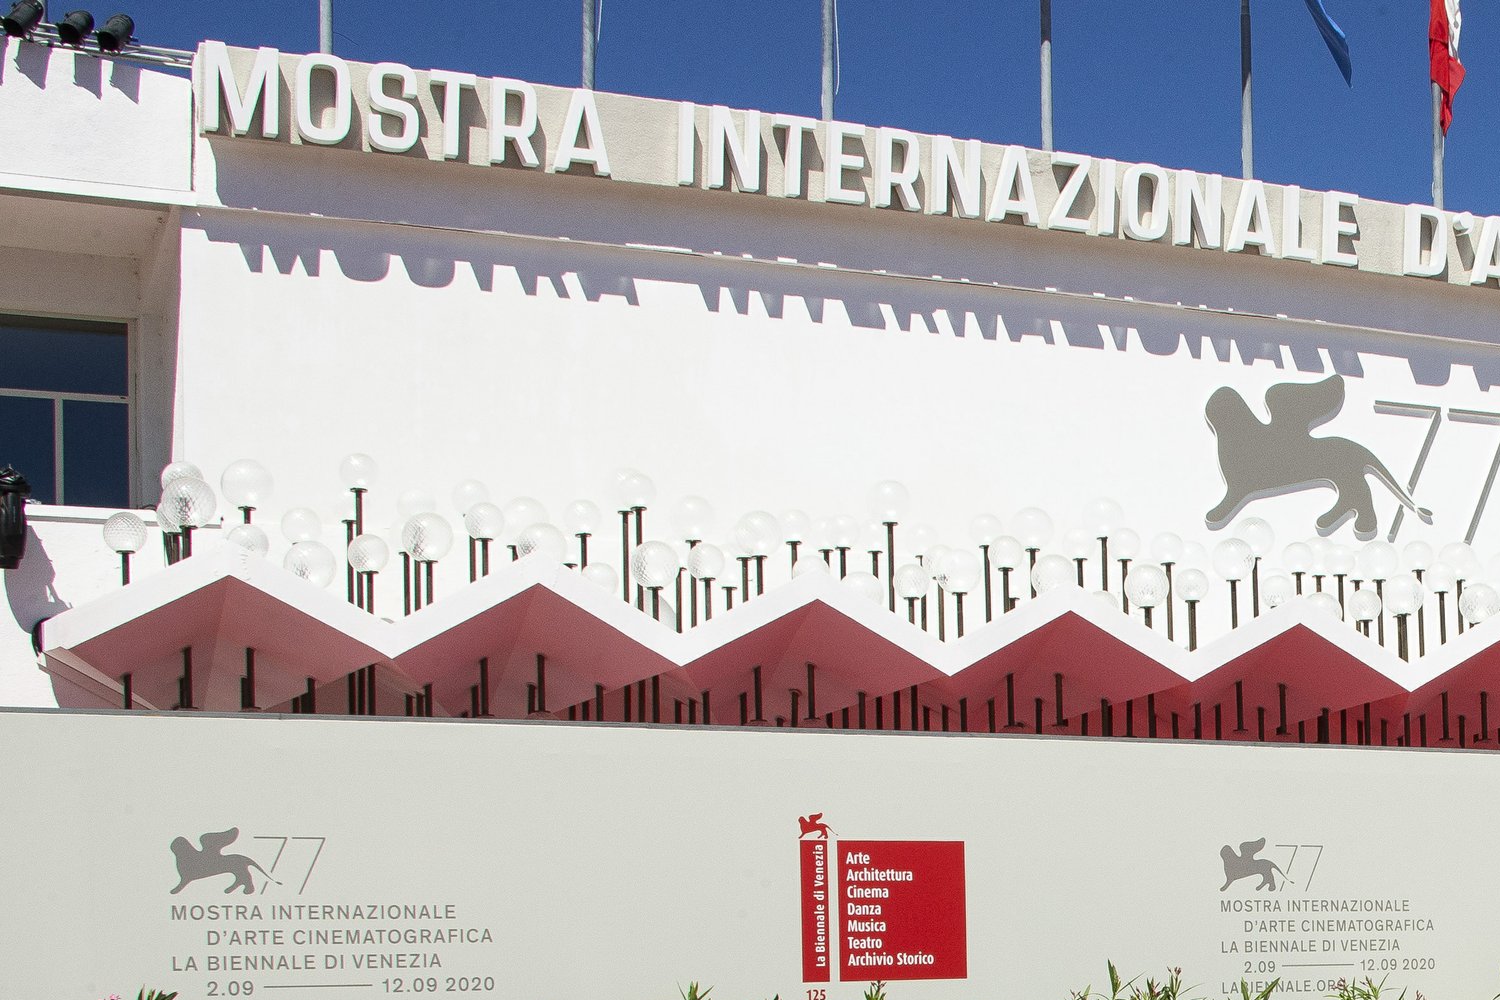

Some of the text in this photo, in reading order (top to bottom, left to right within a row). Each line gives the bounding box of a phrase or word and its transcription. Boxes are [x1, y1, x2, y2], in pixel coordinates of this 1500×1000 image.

[200, 39, 612, 177] MOSTRA
[678, 100, 1359, 267] INTERNAZIONALE
[253, 836, 326, 895] 77
[846, 852, 871, 865] Arte
[846, 868, 913, 882] Architettura
[1275, 844, 1324, 892] 77
[846, 885, 890, 899] Cinema
[171, 904, 457, 921] MOSTRA INTERNAZIONALE
[812, 844, 826, 967] La Biennale di Venezia
[847, 902, 882, 916] Danza
[1220, 899, 1410, 913] MOSTRA INTERNAZIONALE
[847, 919, 887, 932] Musica
[1244, 919, 1435, 933] D'ARTE CINEMATOGRAFICA
[206, 928, 494, 946] D'ARTE CINEMATOGRAFICA
[847, 936, 883, 949] Teatro
[1221, 939, 1401, 954] LA BIENNALE DI VENEZIA
[172, 953, 442, 972] LA BIENNALE DI VENEZIA
[848, 951, 935, 966] Archivio Storico
[1244, 958, 1436, 974] 2.09 12.09 2020
[206, 976, 496, 997] 2.09 12.09 2020
[806, 989, 826, 1000] 125
